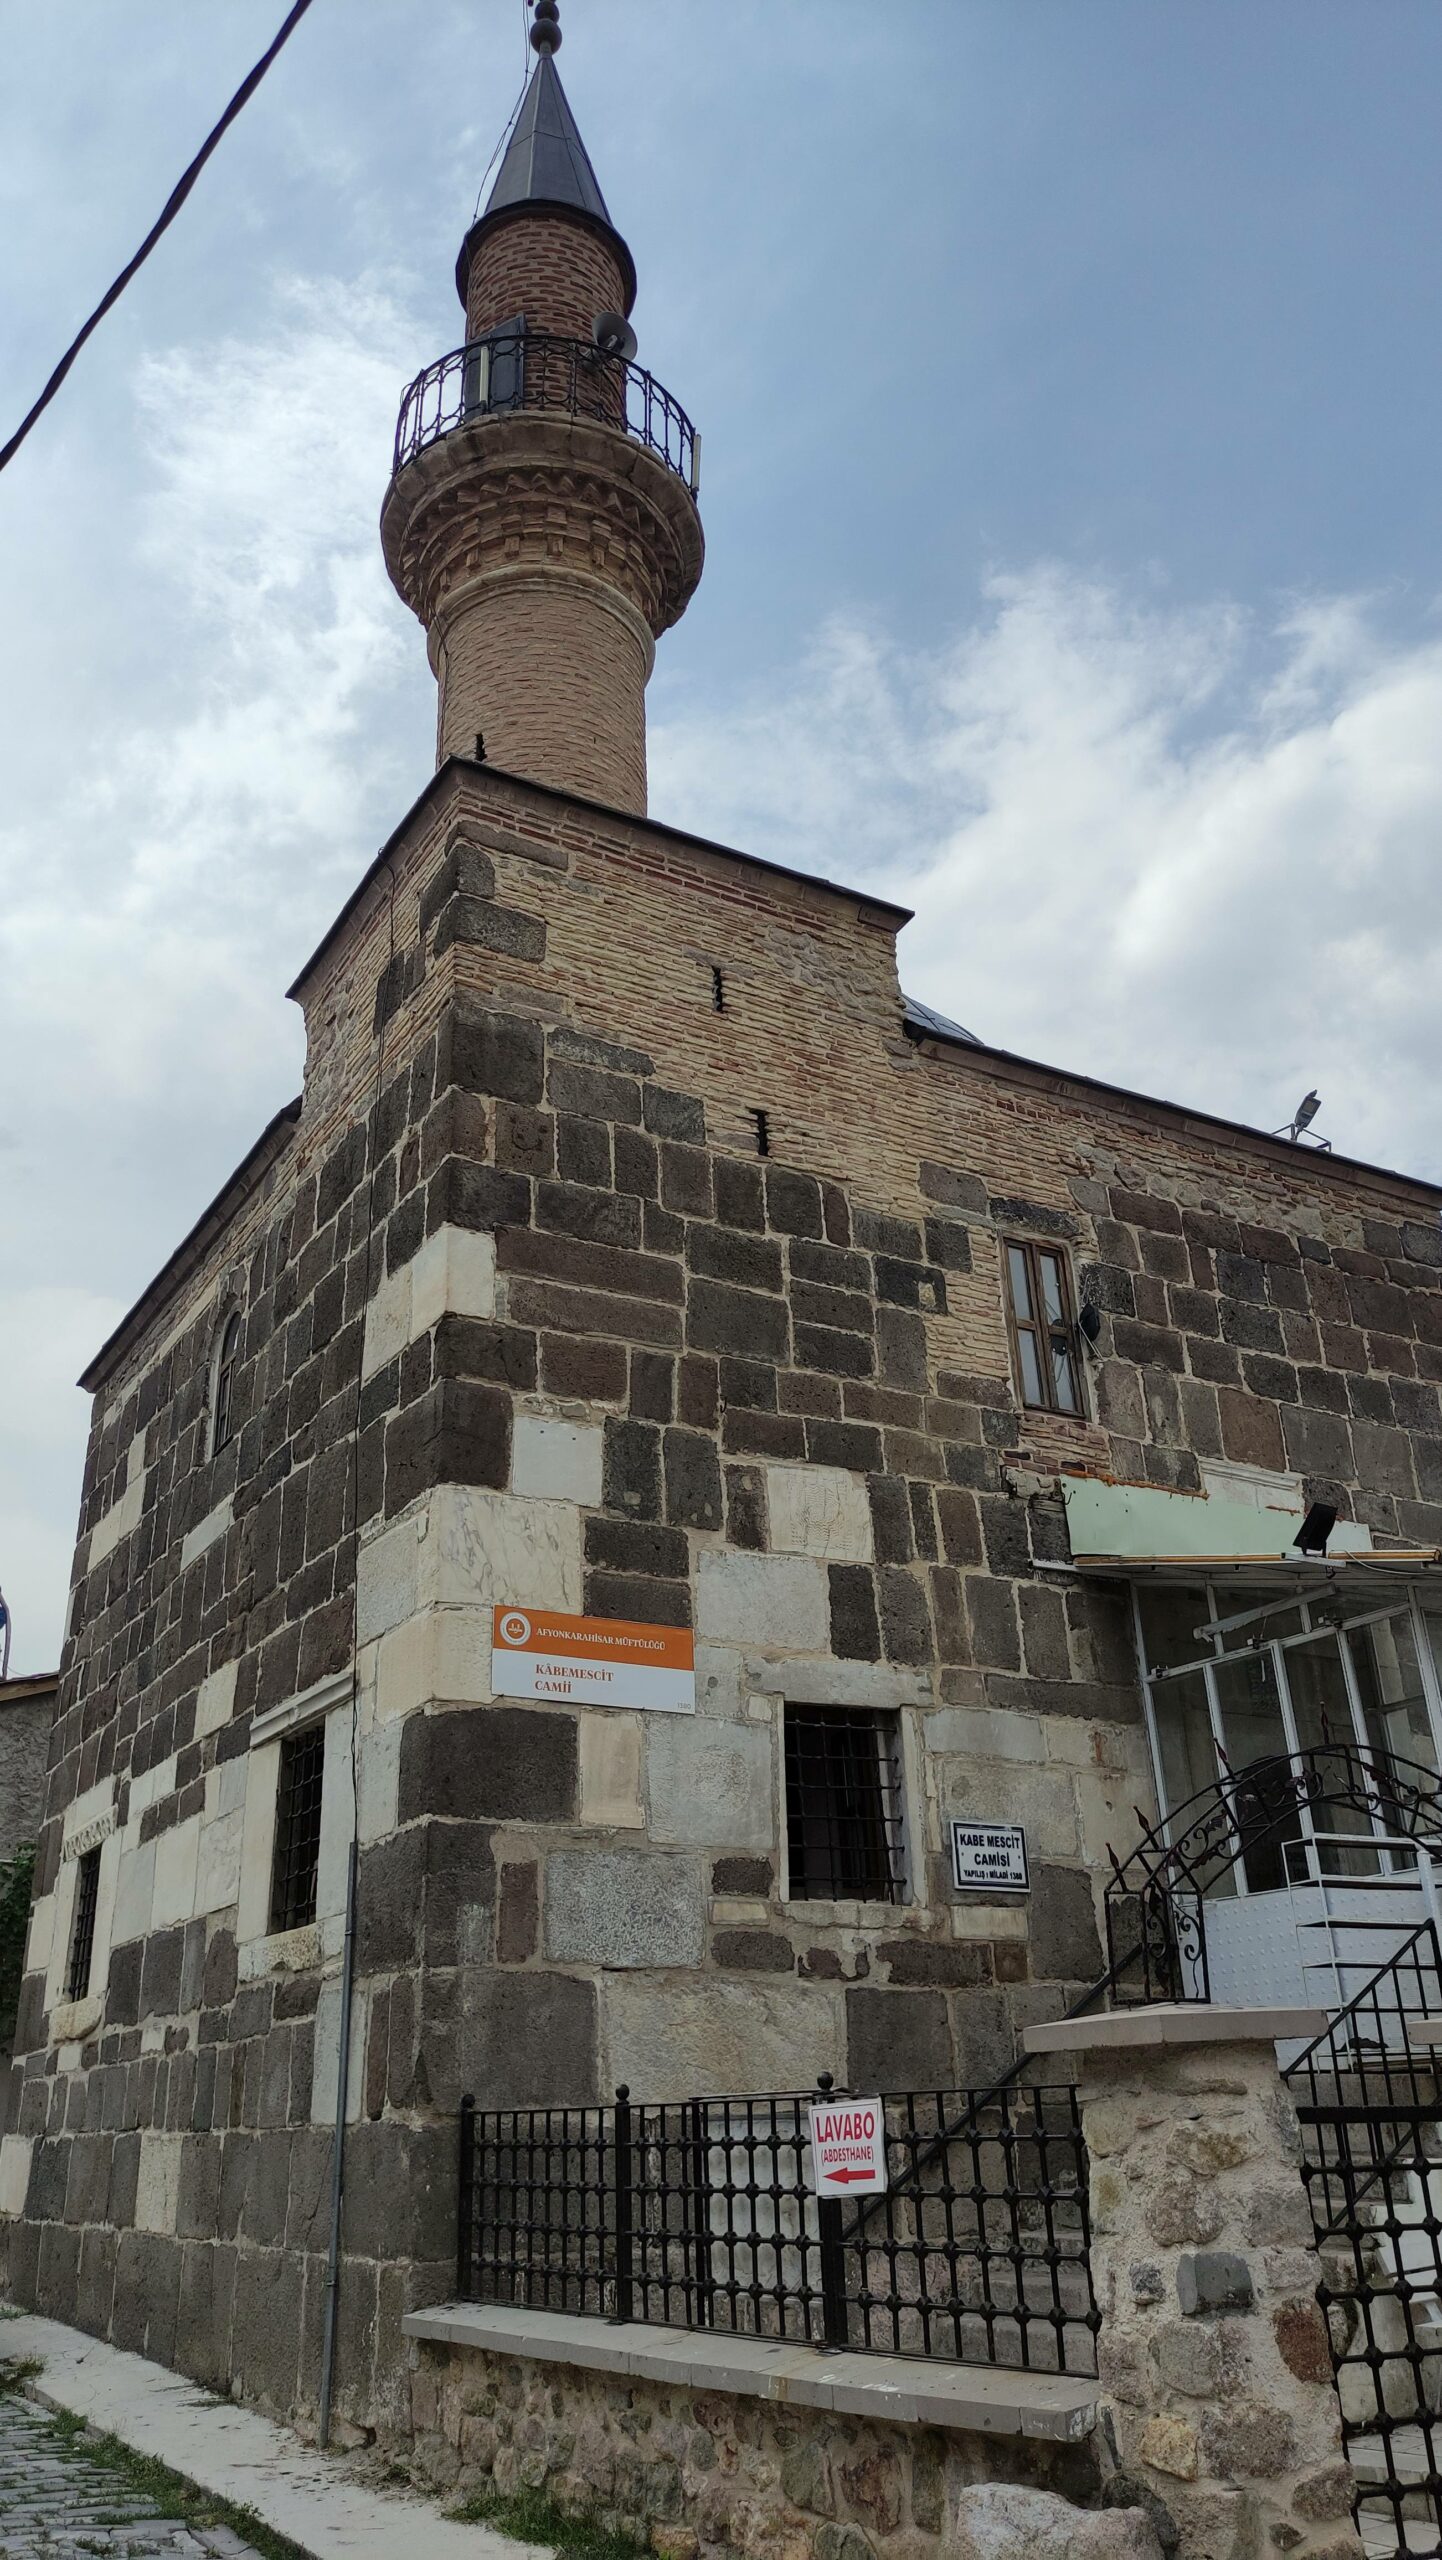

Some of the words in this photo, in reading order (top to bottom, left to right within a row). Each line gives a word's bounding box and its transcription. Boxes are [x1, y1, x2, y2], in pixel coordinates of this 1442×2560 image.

[536, 1627, 614, 1645] AFYONKARAHİSAR
[615, 1636, 665, 1650] MÜFTÜLÜĞÜ
[535, 1663, 614, 1682] KÂBEMESCİT
[535, 1680, 572, 1693] CAMİİ
[960, 1833, 985, 1847] KABE
[987, 1834, 1020, 1849] MESCİT
[974, 1851, 1010, 1867] CAMİSİ
[963, 1869, 985, 1880] YAPILIŞ
[816, 2111, 875, 2143] LAVABO
[821, 2146, 874, 2166] (ABDESTHANE)
